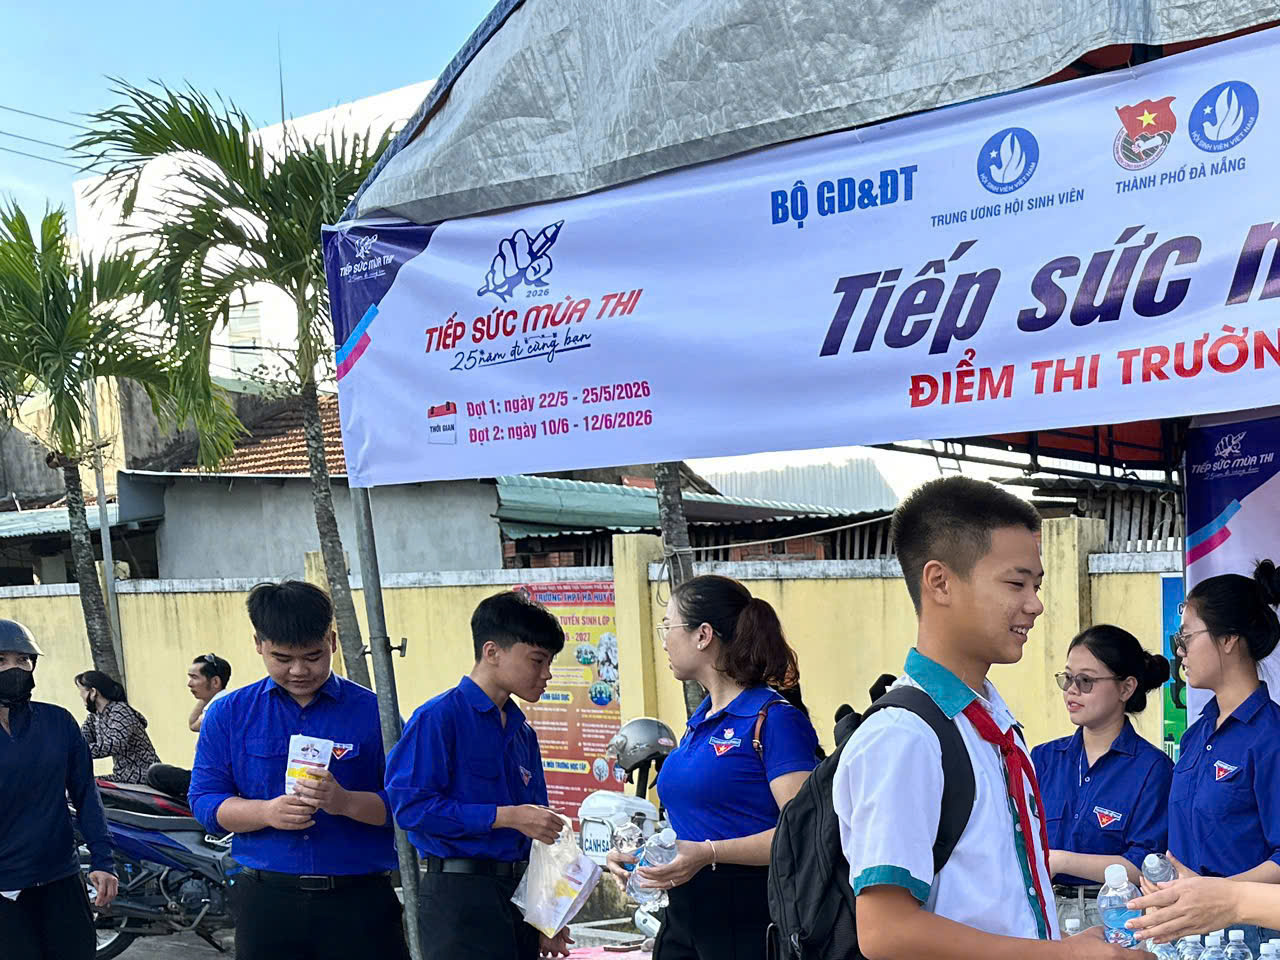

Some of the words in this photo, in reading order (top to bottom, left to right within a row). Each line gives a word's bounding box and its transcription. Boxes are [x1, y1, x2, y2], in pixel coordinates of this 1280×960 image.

[1115, 175, 1156, 194] THÀNH
[1160, 164, 1187, 185] PHỐ
[1189, 163, 1206, 180] ĐÀ
[1210, 156, 1246, 176] NẴNG
[770, 180, 809, 228] BỘ
[817, 164, 918, 218] GD&ĐT
[931, 210, 967, 228] TRUNG
[970, 204, 1001, 221] ƯƠNG
[1004, 198, 1023, 216] HỘI
[1027, 194, 1054, 211] SINH
[1058, 187, 1084, 205] VIÊN
[525, 288, 550, 298] 2026
[819, 239, 1002, 357] Tiếp
[1017, 224, 1202, 332] sức
[425, 311, 466, 353] TIẾP
[471, 306, 518, 344] SỨC
[522, 295, 591, 334] MÙA
[596, 288, 643, 321] THI
[563, 327, 592, 346] bạn
[909, 347, 1015, 409] ĐIỂM
[1032, 354, 1099, 395] THI
[466, 400, 487, 419] Đợt
[489, 400, 501, 414] 1:
[504, 395, 535, 413] ngày
[538, 391, 568, 409] 22/5
[582, 381, 651, 405] 25/5/2026
[442, 423, 455, 432] GIAN
[469, 427, 490, 446] Đợt
[492, 425, 504, 441] 2:
[508, 422, 537, 440] ngày
[541, 418, 569, 436] 10/6
[583, 409, 653, 432] 12/6/2026
[1191, 461, 1211, 474] TIẾP
[1212, 459, 1231, 471] SỨC
[1231, 454, 1257, 468] MÙA
[1259, 452, 1274, 464] THI
